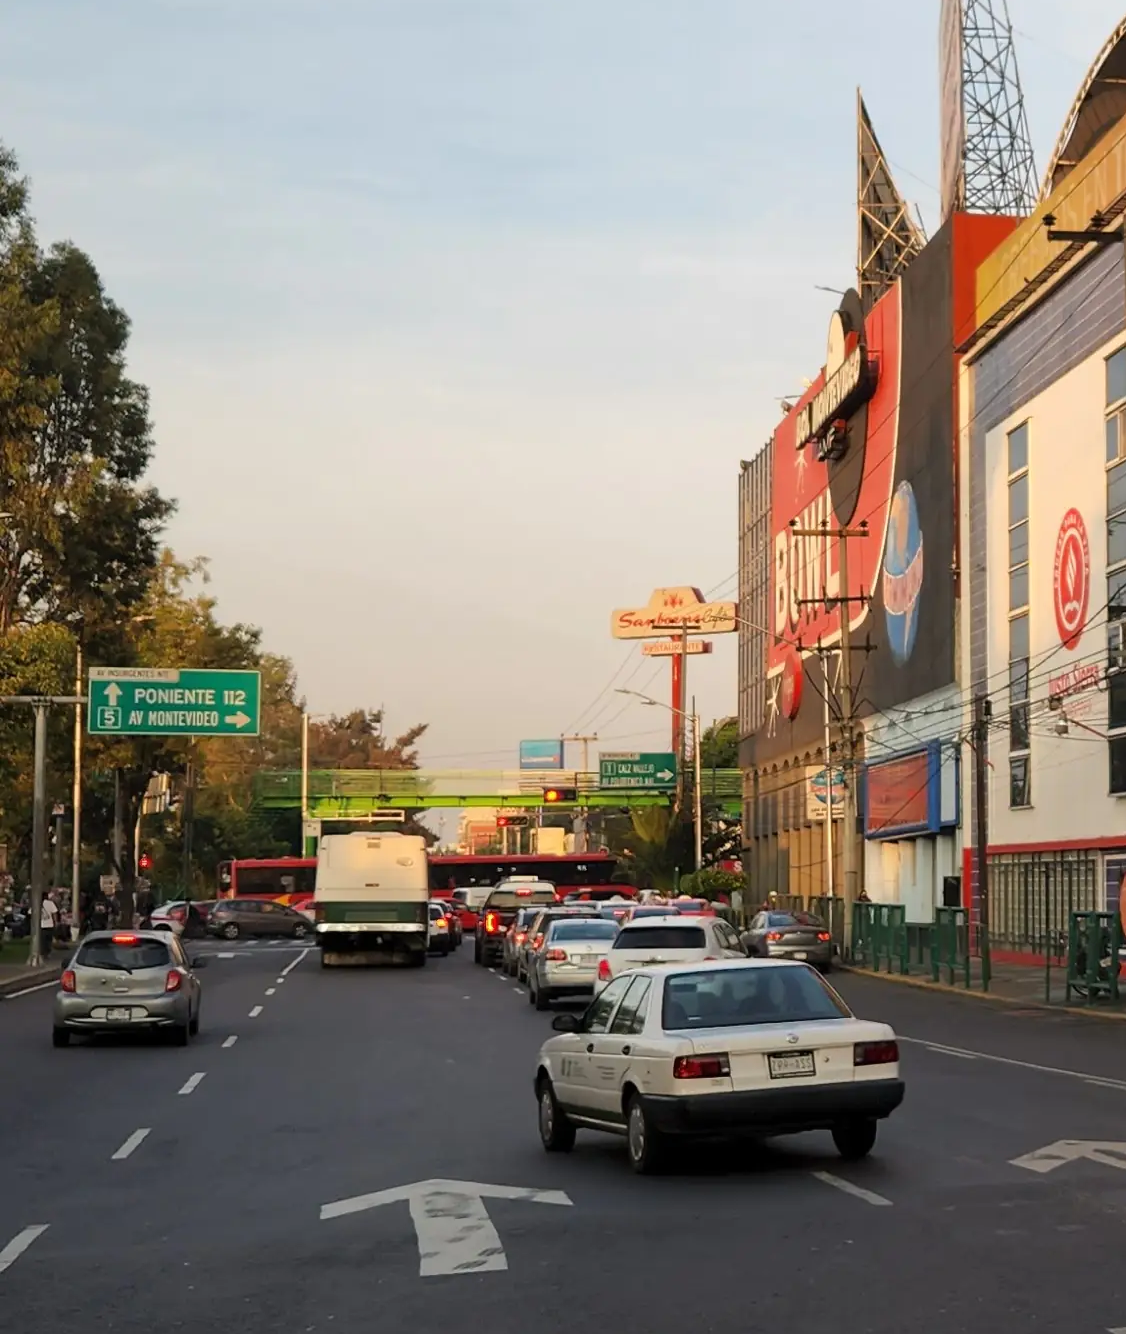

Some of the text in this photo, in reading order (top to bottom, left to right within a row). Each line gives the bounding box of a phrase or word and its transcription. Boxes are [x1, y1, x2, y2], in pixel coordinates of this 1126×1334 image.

[775, 485, 840, 637] BOWL
[134, 688, 246, 706] PONIENTE 112
[103, 709, 116, 726] 5
[128, 709, 219, 727] AV MONTEVIDEO
